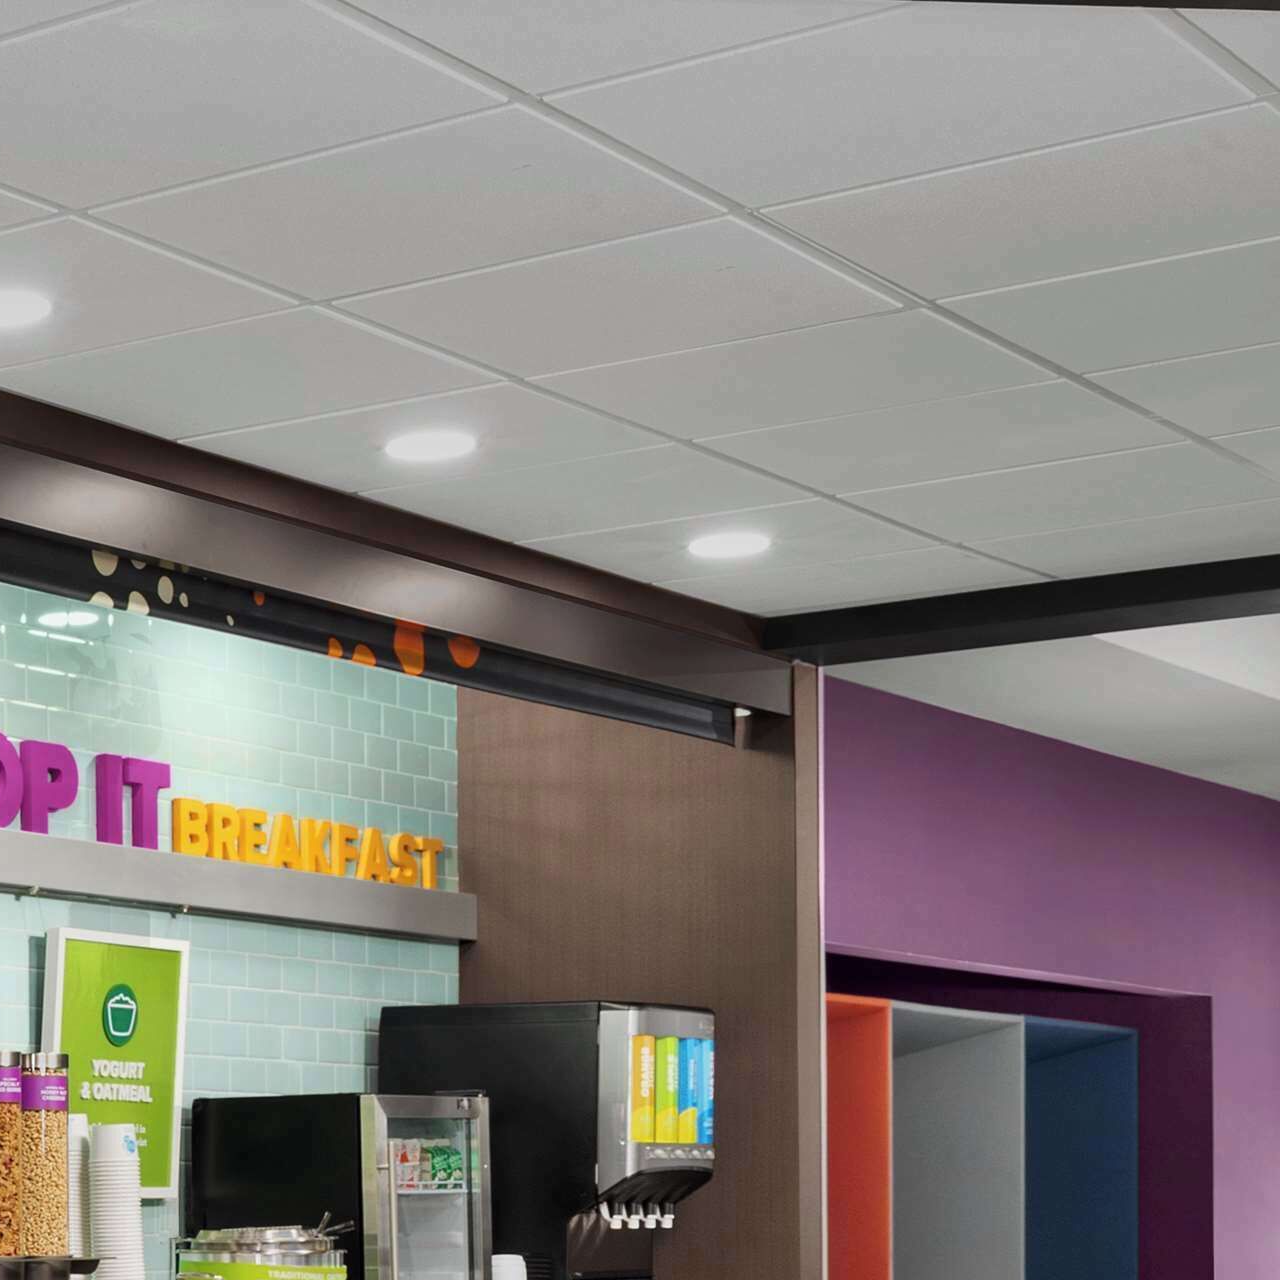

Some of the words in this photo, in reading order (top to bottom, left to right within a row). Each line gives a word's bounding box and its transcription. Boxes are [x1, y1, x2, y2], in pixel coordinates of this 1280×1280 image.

[96, 753, 170, 849] IT
[171, 797, 444, 890] BREAKFAST
[80, 1082, 91, 1100] &
[93, 1083, 153, 1103] OATMEAL
[92, 1059, 145, 1080] YOGURT
